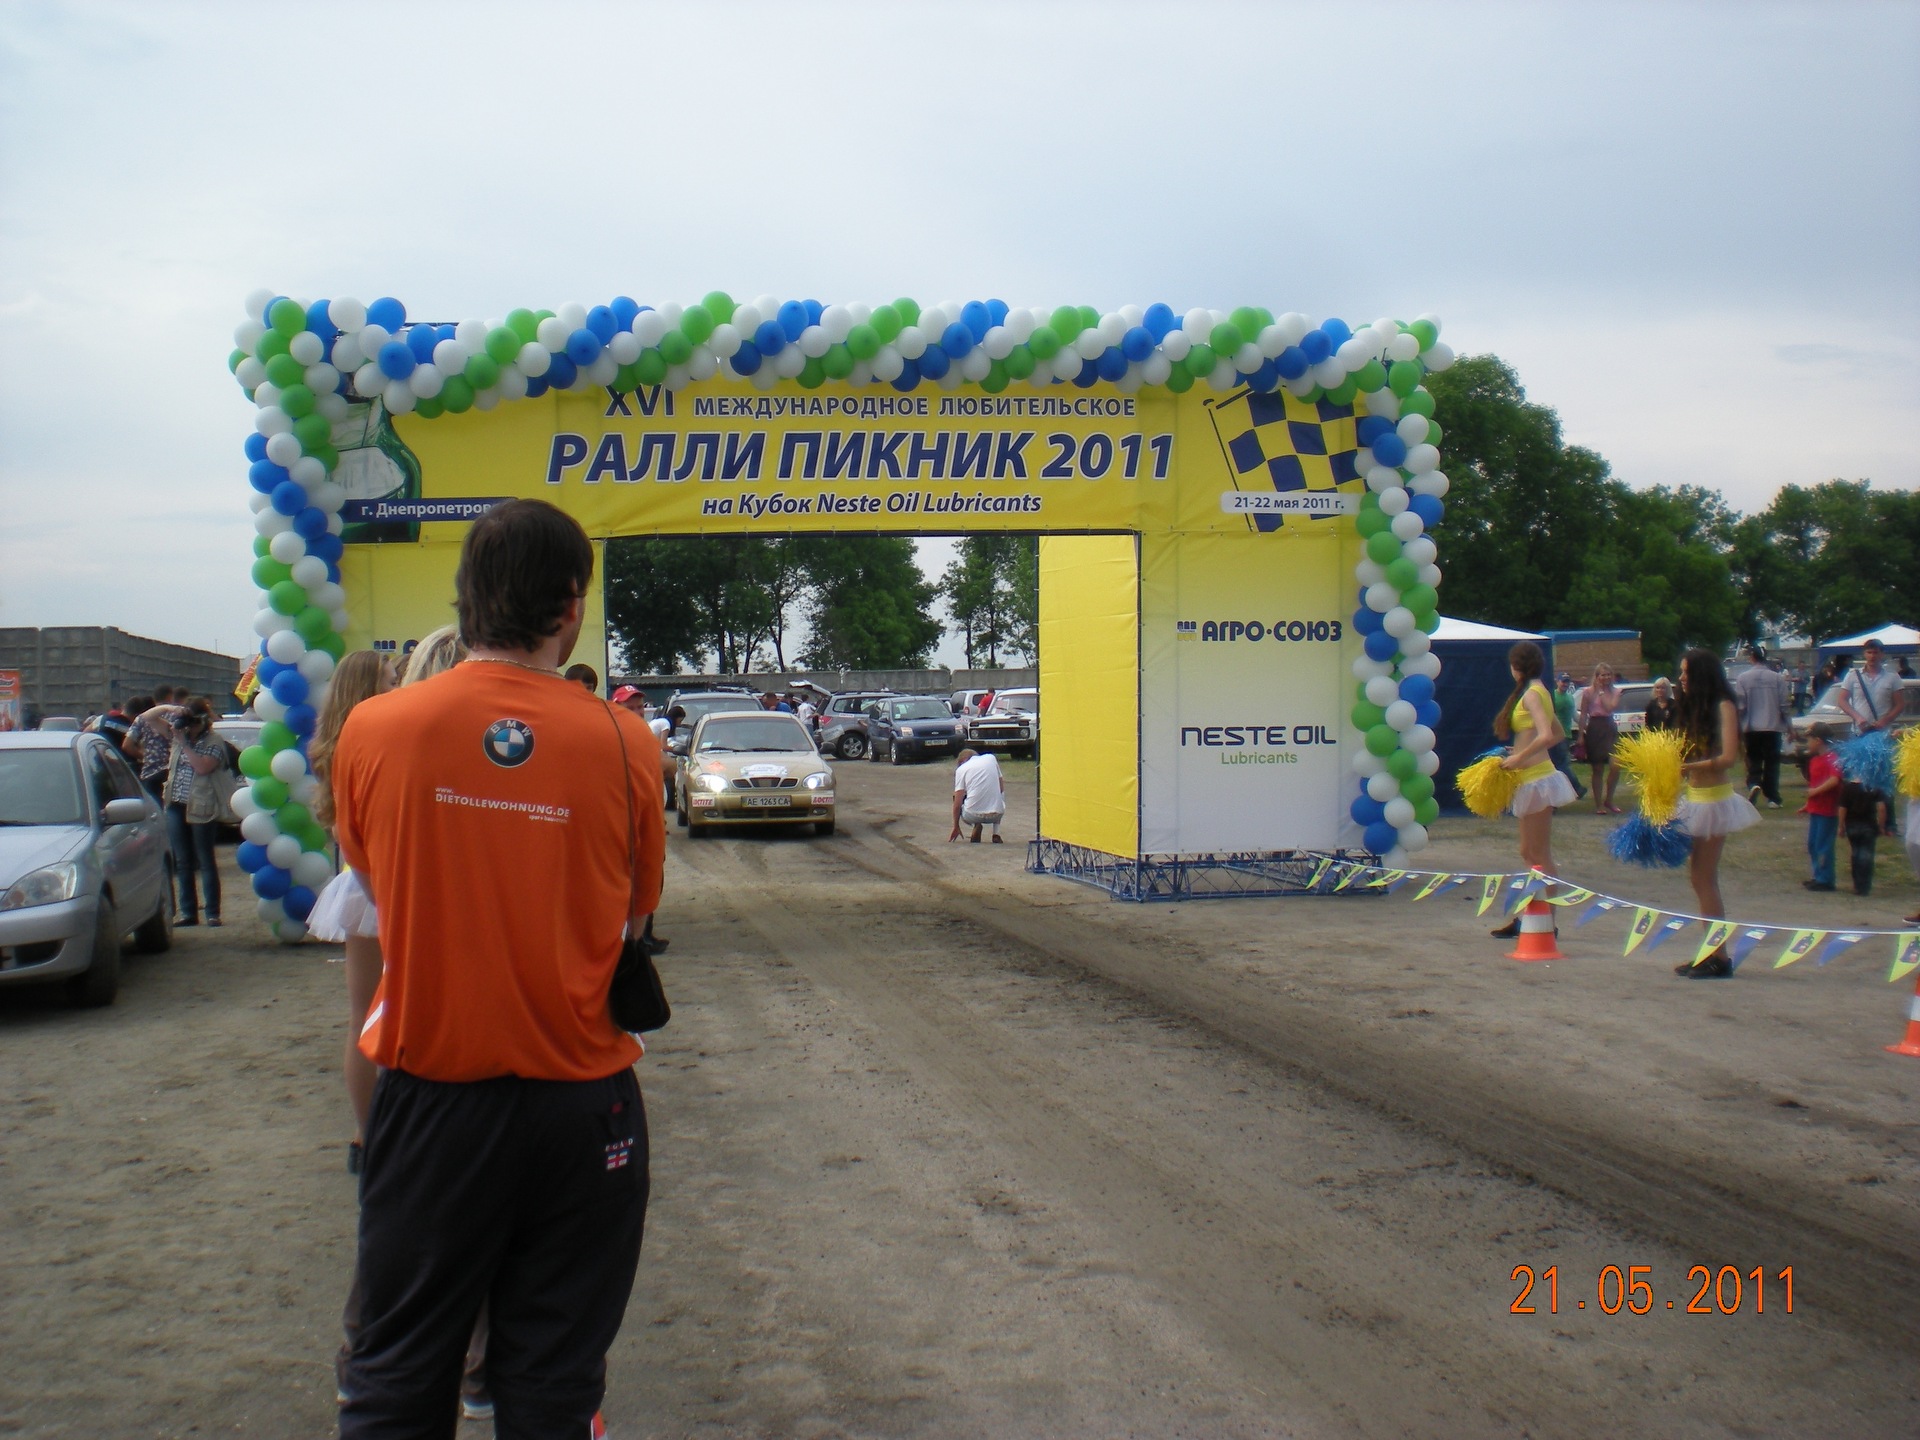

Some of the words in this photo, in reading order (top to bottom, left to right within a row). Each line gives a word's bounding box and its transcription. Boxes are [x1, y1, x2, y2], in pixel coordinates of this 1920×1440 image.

[604, 383, 675, 417] XVI
[694, 396, 929, 420] МЕЖДУНАРОДНОЕ
[938, 397, 1136, 417] ЛЮБИТЕЛЬСКОЕ
[546, 430, 767, 483] РАЛЛИ
[776, 431, 1036, 480] ПИКНИК
[1040, 433, 1174, 480] 2011
[361, 506, 373, 516] г.
[702, 498, 732, 515] на
[738, 493, 813, 519] Кубок
[816, 491, 880, 514] Neste
[887, 491, 918, 513] Oil
[923, 491, 1042, 513] Lubricants
[1234, 497, 1271, 508] 21-22
[1273, 499, 1300, 509] мая
[1302, 497, 1331, 509] 2011
[1335, 499, 1345, 509] г.
[490, 720, 531, 737] BMW
[1181, 726, 1287, 746] NESTE
[1293, 725, 1337, 745] OIL
[1221, 751, 1298, 765] Lubricants
[435, 793, 570, 817] DIETOLLEWOHNUNG.DE
[760, 798, 777, 806] 1263
